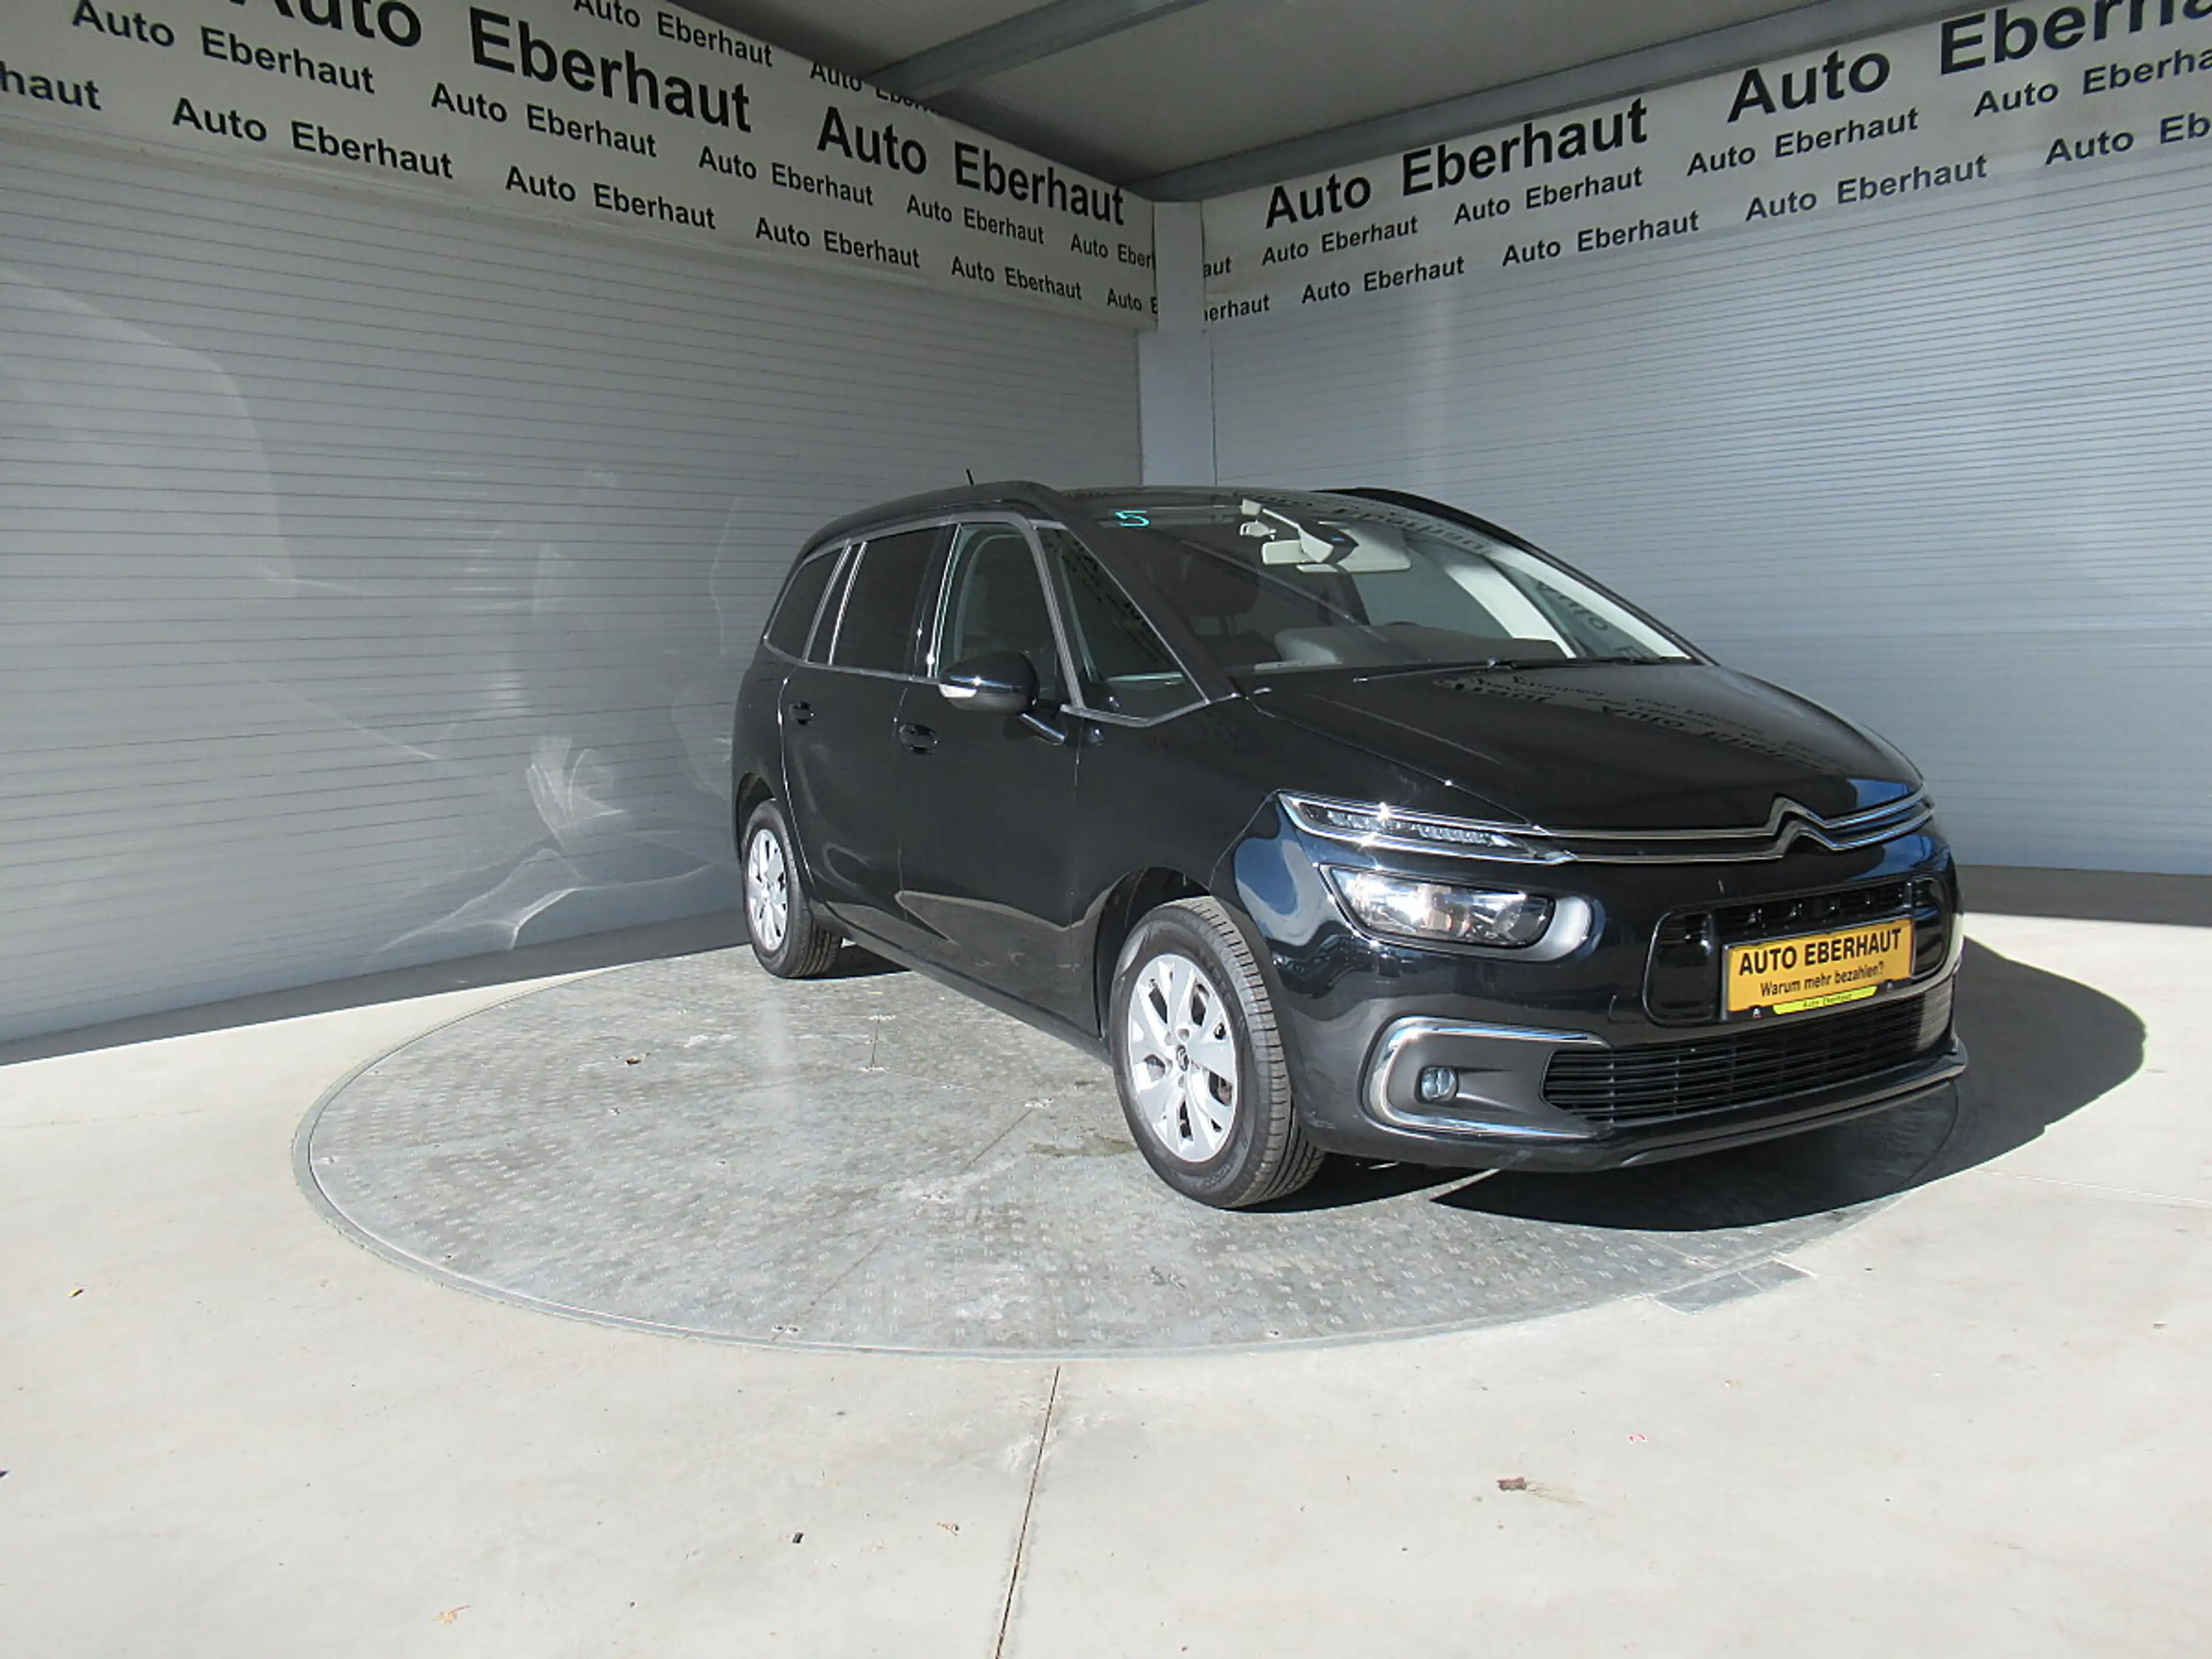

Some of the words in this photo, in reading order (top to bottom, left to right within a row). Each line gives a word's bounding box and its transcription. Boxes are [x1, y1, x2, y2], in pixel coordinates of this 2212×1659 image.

[72, 0, 174, 46] Auto
[201, 26, 374, 94] Eberhaut
[230, 0, 421, 47] uto
[470, 6, 751, 133] Eberhaut
[658, 11, 772, 67] Eberhaut
[1727, 50, 1889, 123] Auto
[1974, 83, 2058, 117] Auto
[172, 98, 266, 141] Auto
[291, 121, 452, 179] Eberhaut
[431, 83, 507, 122] Auto
[527, 104, 656, 157] Eberhaut
[1687, 146, 1755, 176] Auto
[1776, 108, 1918, 157] Eberhaut
[2046, 131, 2134, 165] Auto
[2161, 113, 2210, 144] Eb
[699, 146, 756, 179] Auto
[772, 162, 873, 206] Eberhaut
[817, 107, 926, 174] Auto
[955, 141, 1124, 225] Eberhaut
[1266, 174, 1370, 229] Auto
[1403, 97, 1647, 197] Eberhaut
[1746, 192, 1816, 222] Auto
[1838, 154, 1986, 204] Eberhaut
[506, 166, 575, 201] Auto
[594, 183, 715, 229] Eberhaut
[907, 195, 952, 222] Auto
[964, 207, 1044, 244] Eberhaut
[1455, 198, 1510, 225] Auto
[1527, 166, 1642, 209] Eberhaut
[756, 218, 809, 247] Auto
[824, 230, 920, 268] Eberhaut
[1071, 233, 1108, 258] Auto
[1262, 243, 1308, 266] Auto
[1322, 216, 1417, 253] Eberhaut
[1502, 240, 1560, 266] Auto
[1578, 211, 1698, 252] Eberhaut
[952, 256, 994, 282] Auto
[1005, 267, 1081, 300] Eberhaut
[1108, 288, 1142, 311] Auto
[1302, 281, 1350, 304] Auto
[1364, 256, 1464, 291] Eberhaut
[1739, 945, 1797, 976] AUTO
[1805, 929, 1901, 966] EBERHAUT
[1760, 978, 1800, 997] Warum
[1804, 972, 1832, 991] mehr
